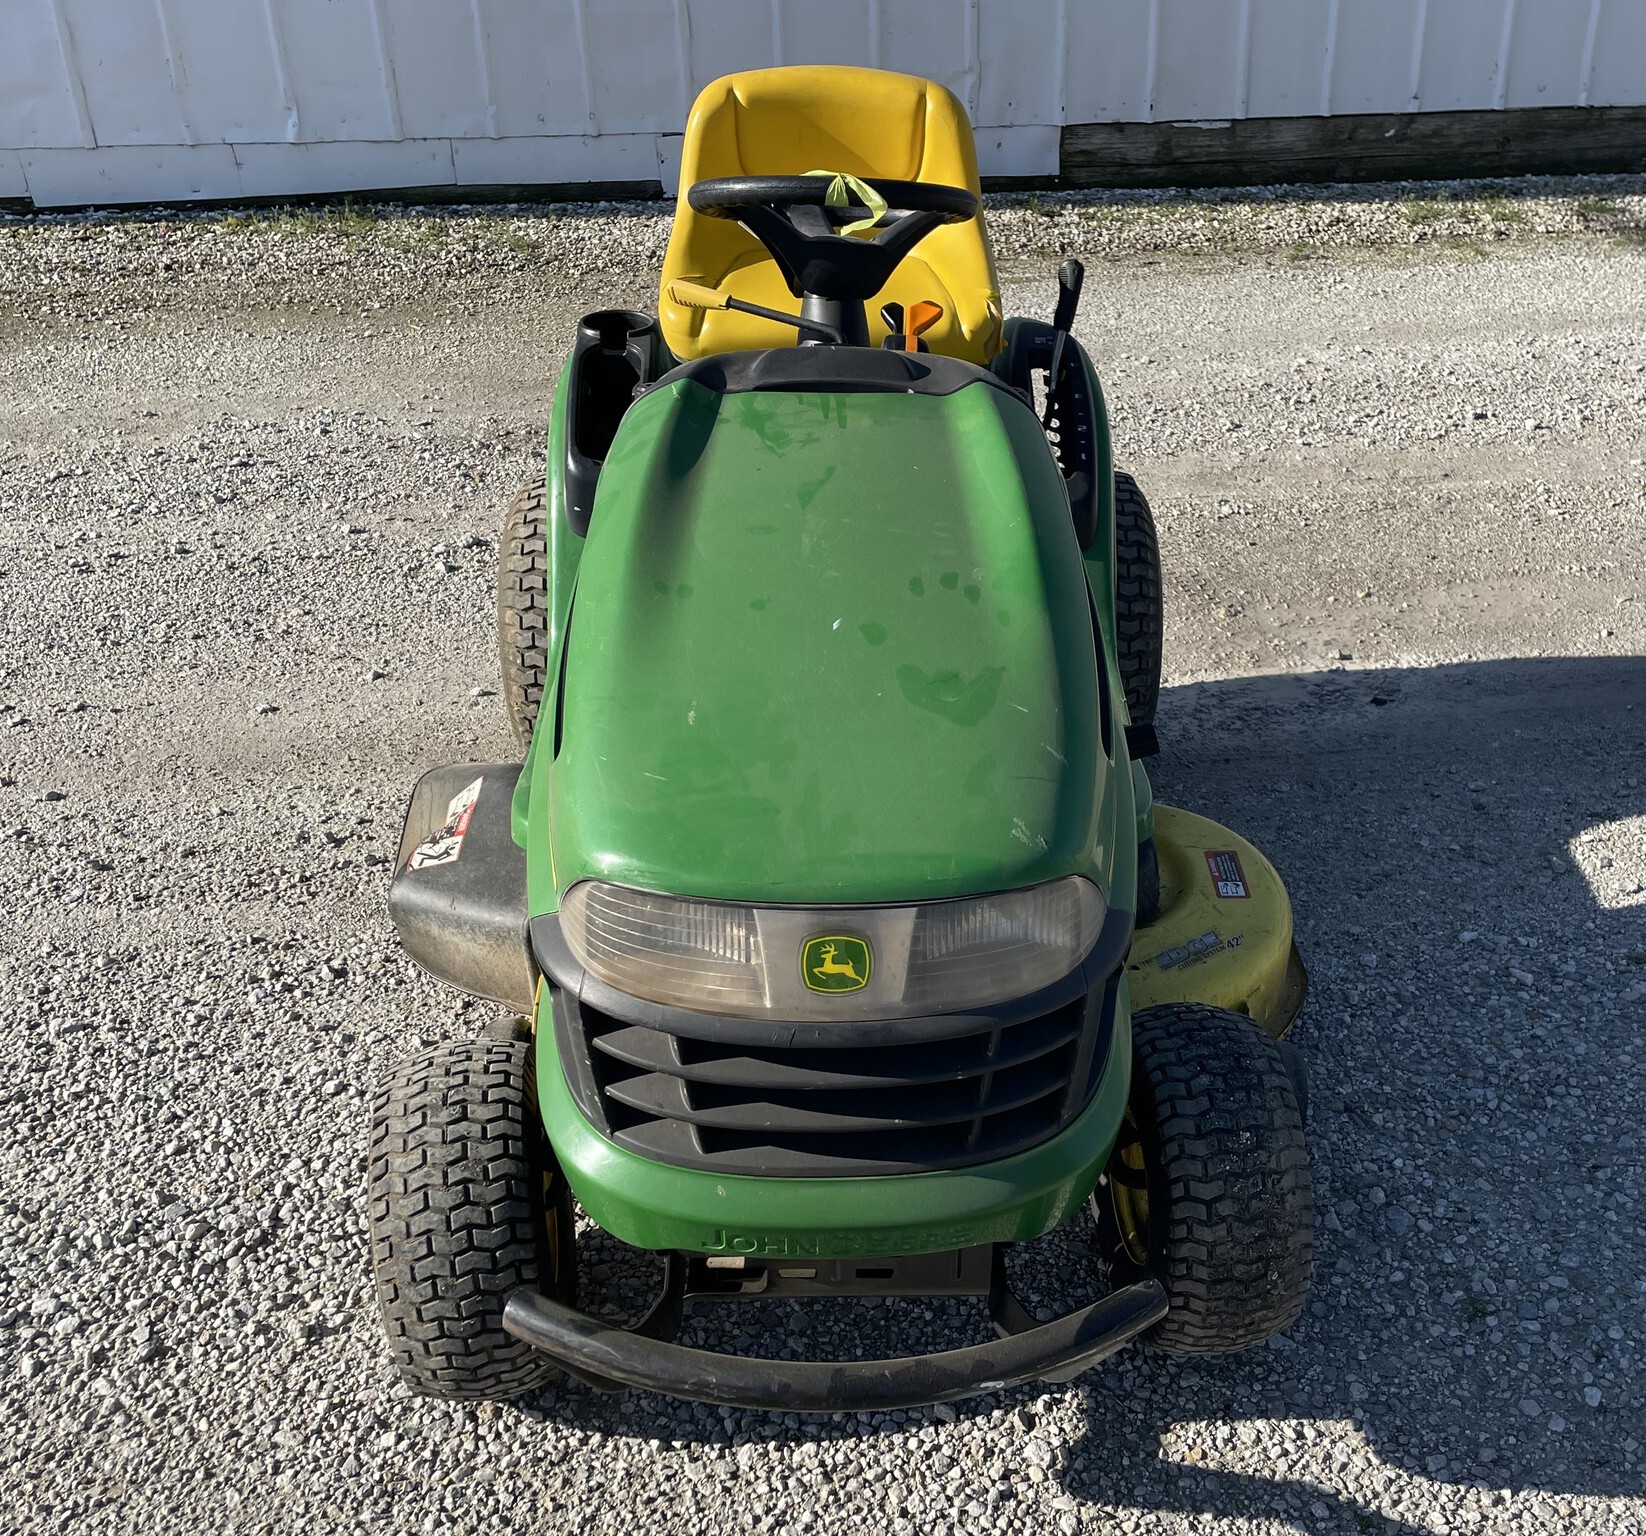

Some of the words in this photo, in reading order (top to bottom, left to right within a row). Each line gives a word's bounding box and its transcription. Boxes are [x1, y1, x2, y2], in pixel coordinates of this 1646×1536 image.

[1154, 929, 1222, 971] EDGE
[1204, 944, 1227, 960] SYSTEM
[701, 1229, 820, 1255] JOHN
